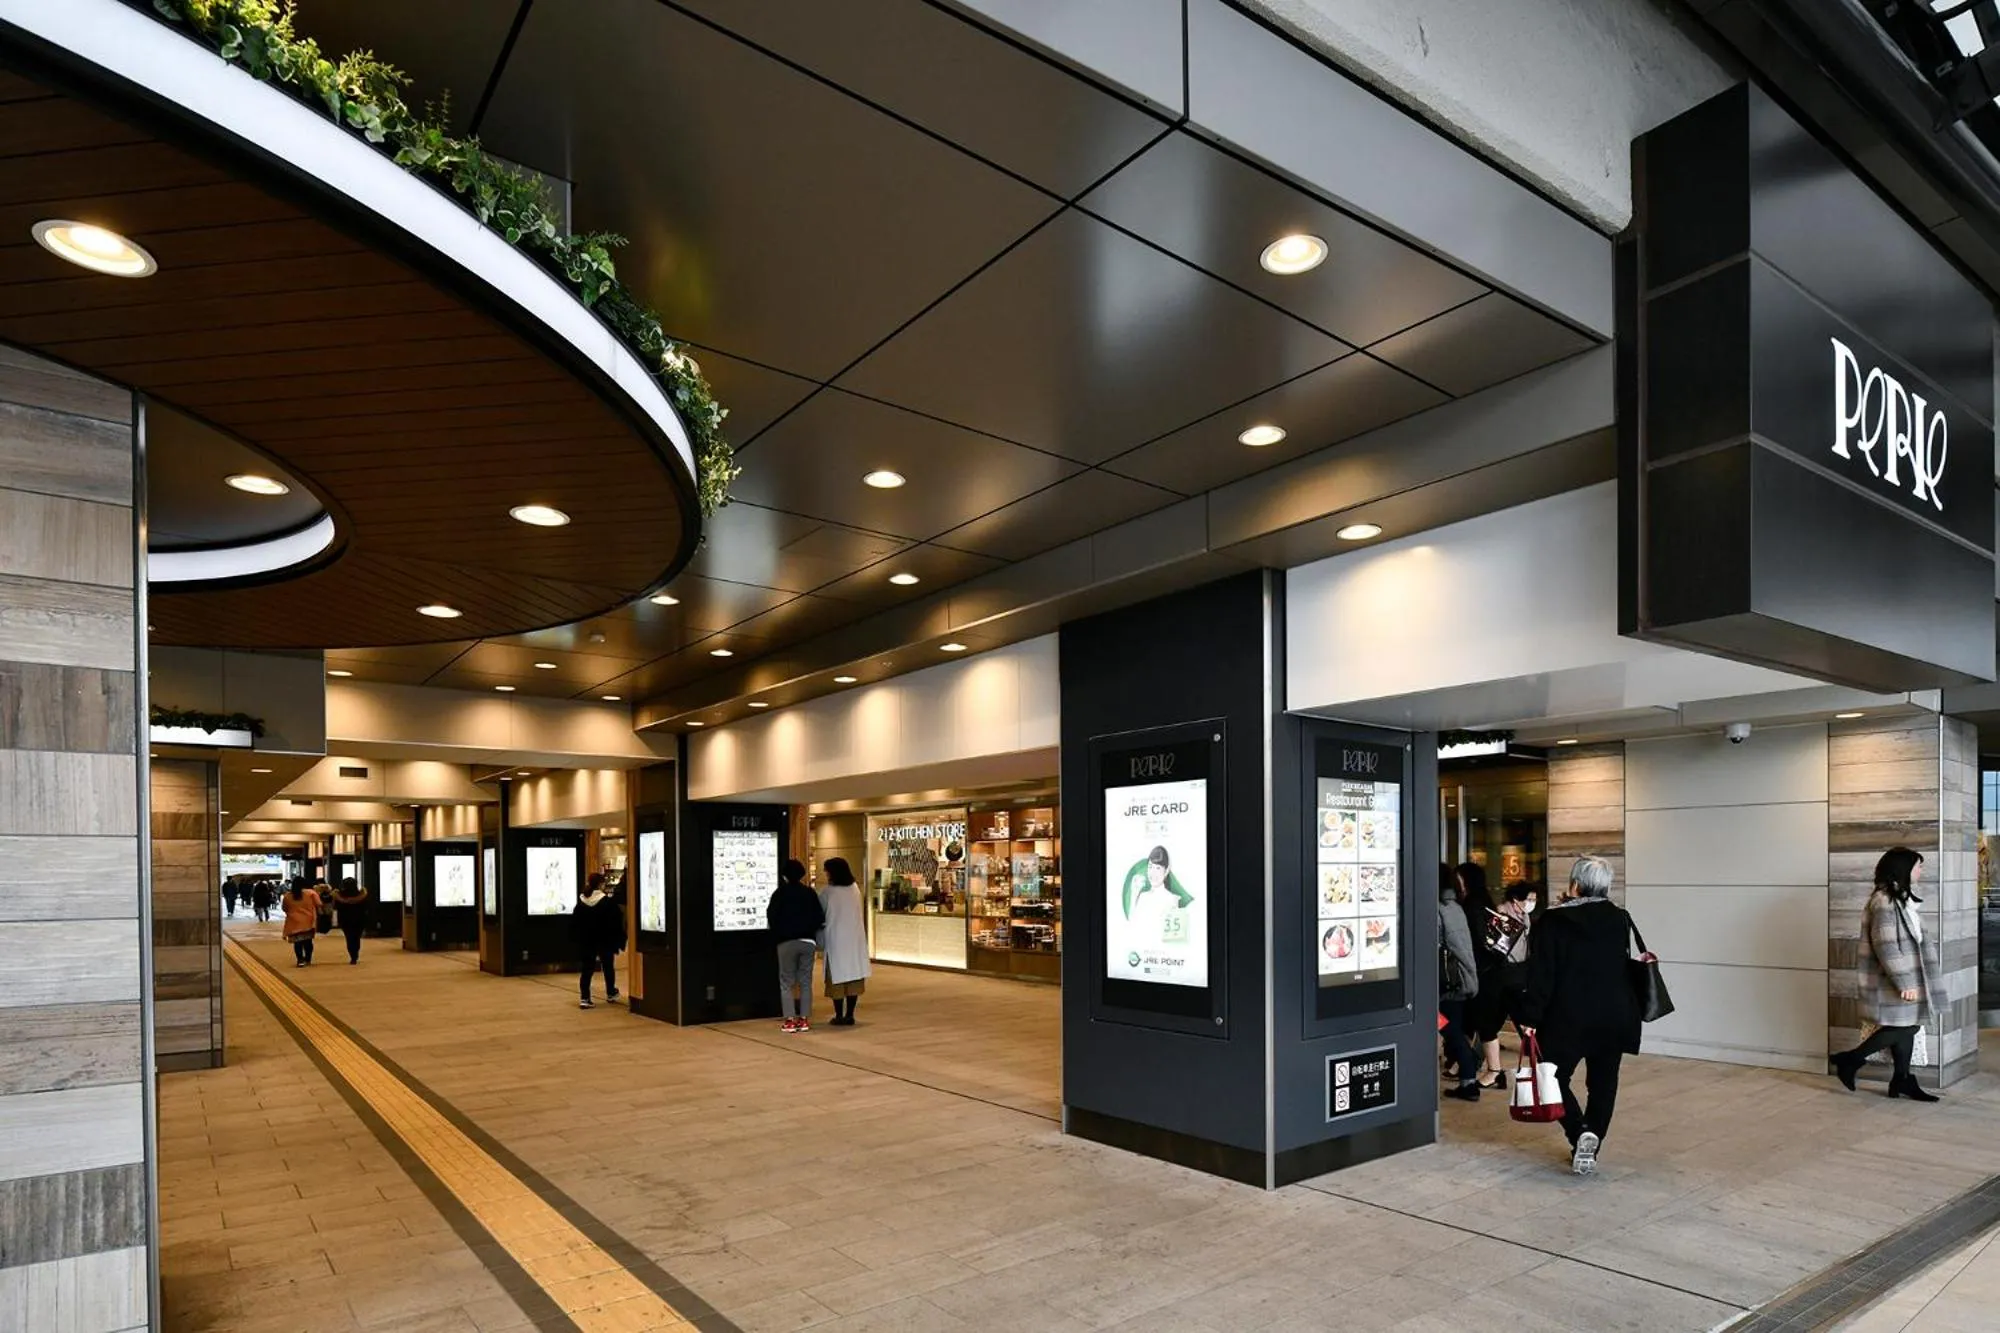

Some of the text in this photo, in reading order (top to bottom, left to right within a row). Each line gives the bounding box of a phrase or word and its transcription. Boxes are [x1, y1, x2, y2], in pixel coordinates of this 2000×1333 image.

[1124, 801, 1189, 817] JRE CARD
[896, 824, 934, 840] KITCHEN
[935, 822, 966, 840] STORE
[1161, 958, 1185, 967] POINT
